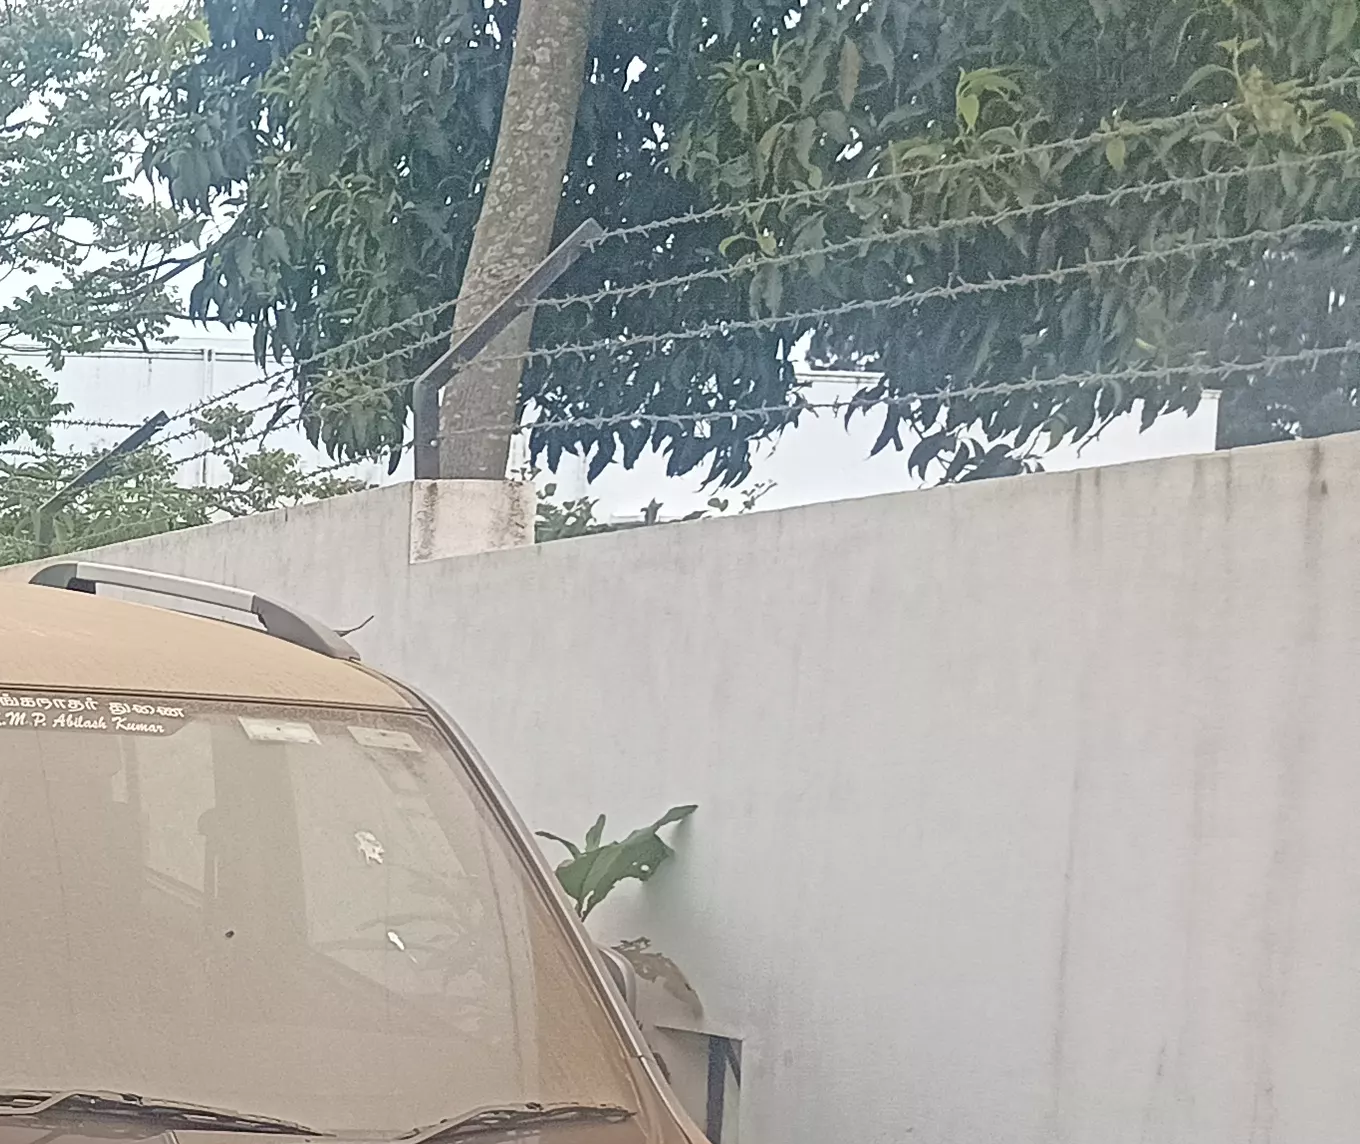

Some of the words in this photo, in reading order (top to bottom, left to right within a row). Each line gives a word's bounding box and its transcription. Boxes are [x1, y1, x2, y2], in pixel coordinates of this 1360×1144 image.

[109, 702, 184, 717] துணை
[52, 713, 107, 729] Abilash
[111, 716, 165, 733] Kumar
